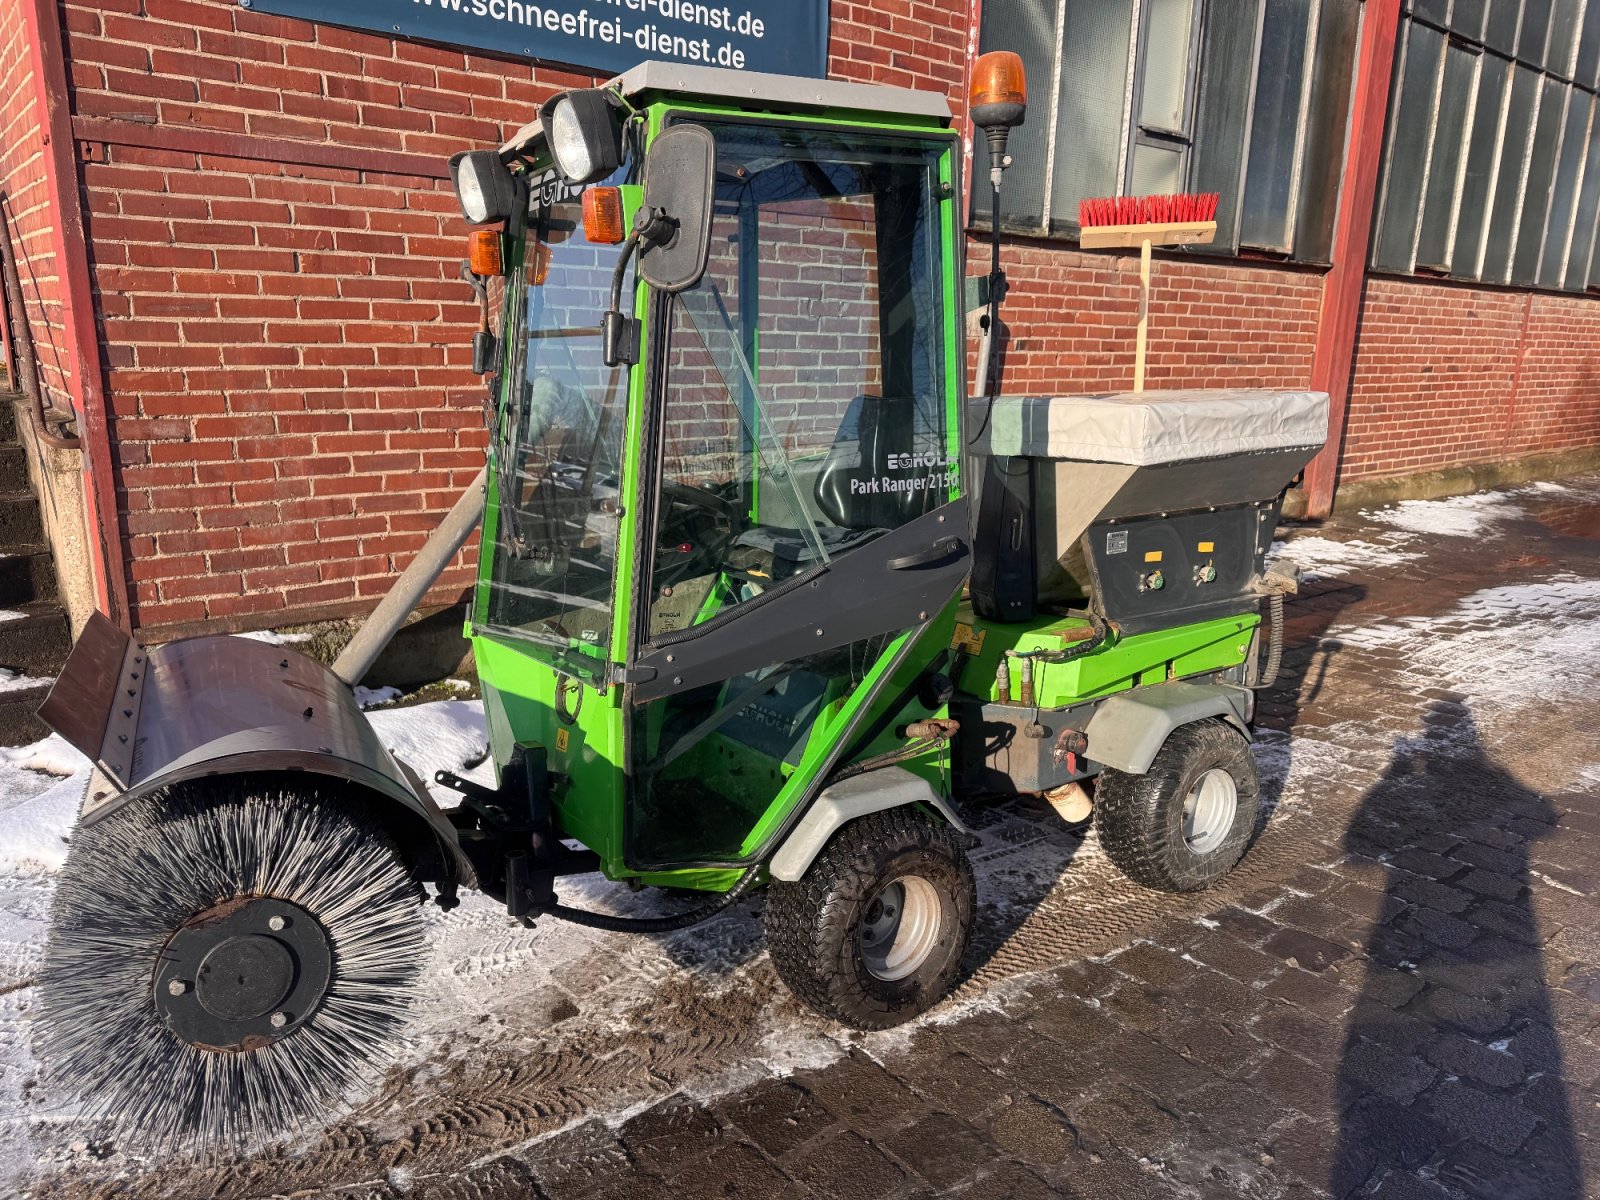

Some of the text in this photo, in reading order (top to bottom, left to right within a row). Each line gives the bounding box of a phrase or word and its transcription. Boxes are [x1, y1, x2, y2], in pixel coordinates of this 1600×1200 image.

[413, 0, 746, 69] w.schneefrei-dienst.de
[600, 0, 765, 38] ei-dienst.de
[850, 472, 957, 495] Park Ranger 2150
